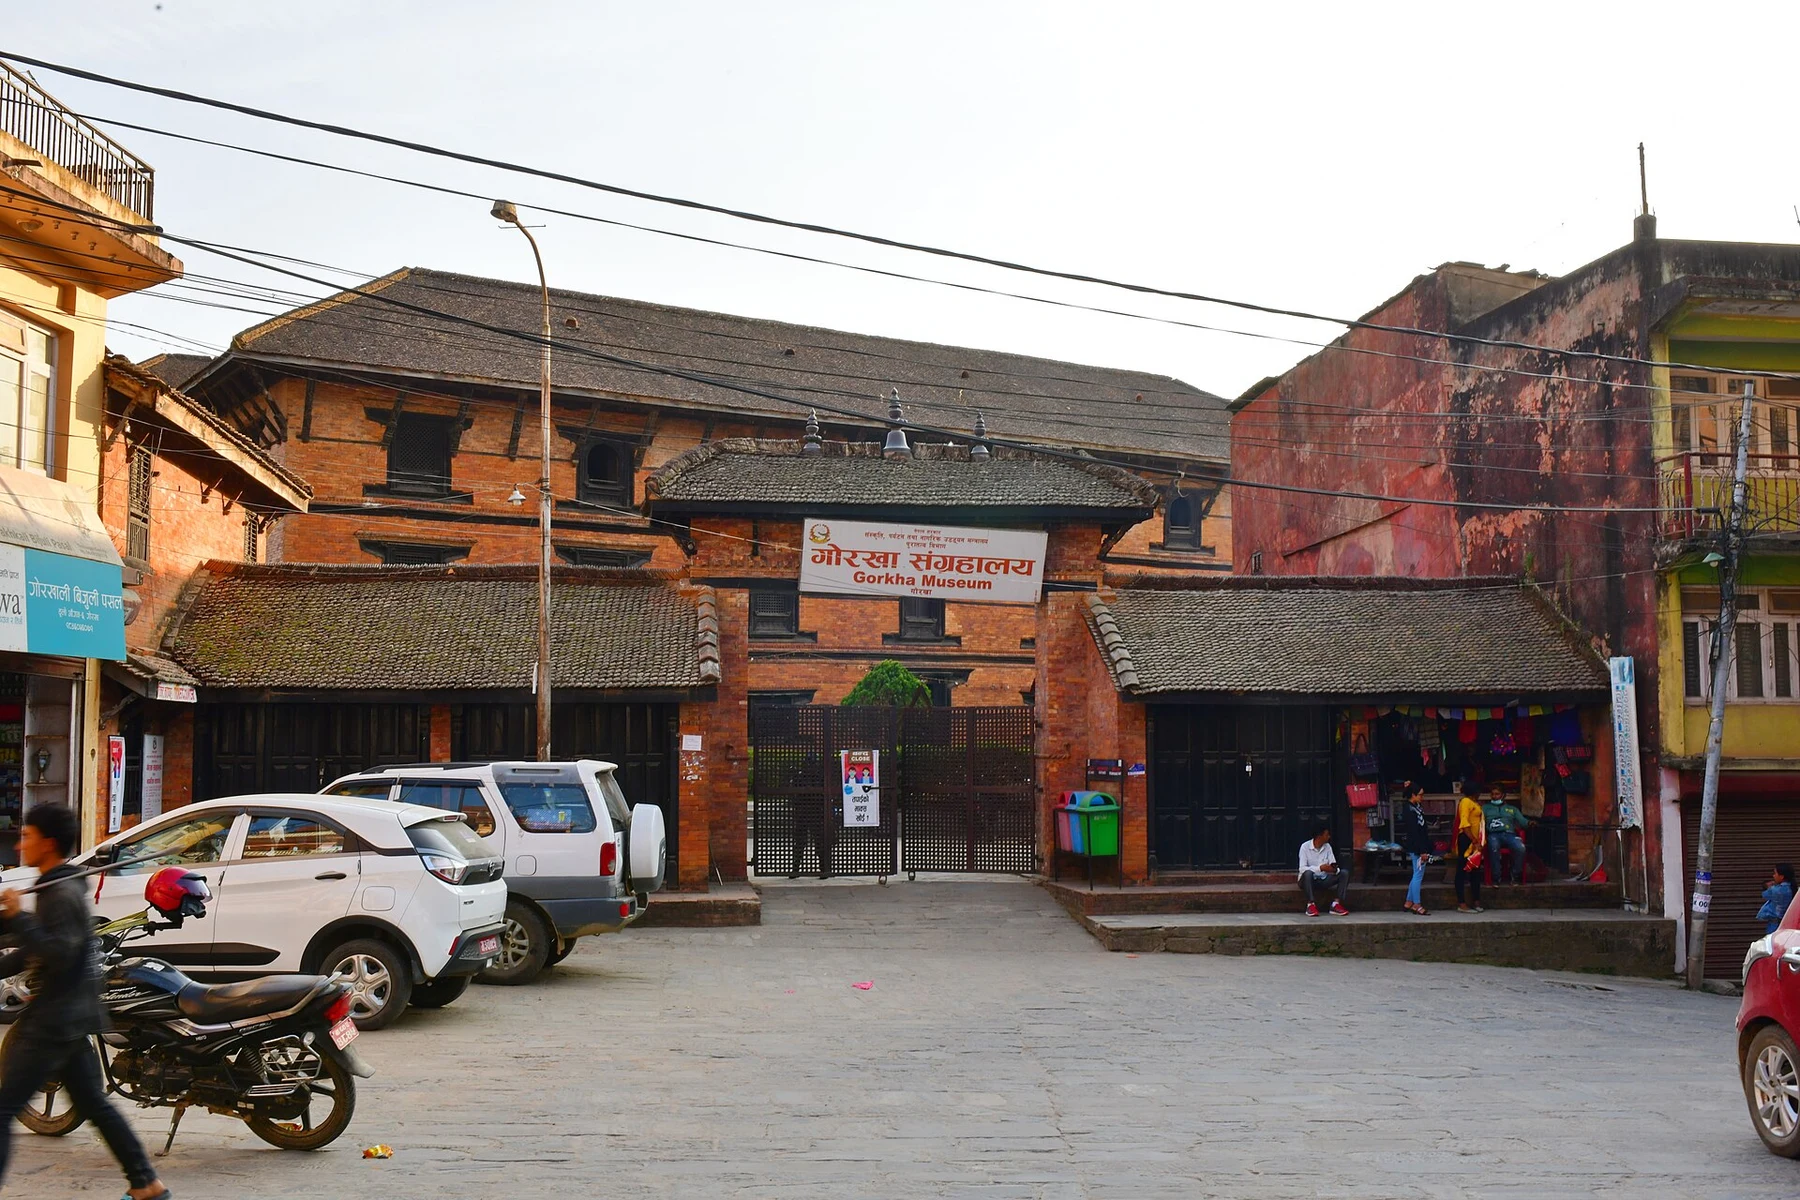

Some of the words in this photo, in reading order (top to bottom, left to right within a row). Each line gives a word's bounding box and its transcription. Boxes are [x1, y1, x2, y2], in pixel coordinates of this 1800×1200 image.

[811, 543, 901, 569] गोरखा
[909, 550, 1036, 577] संग्रहालय
[28, 576, 71, 602] गोरखाली
[73, 585, 99, 610] बिजुली
[101, 594, 122, 610] पसल
[853, 571, 916, 586] Gorkha
[921, 574, 992, 590] Museum
[910, 588, 932, 596] गोरखा
